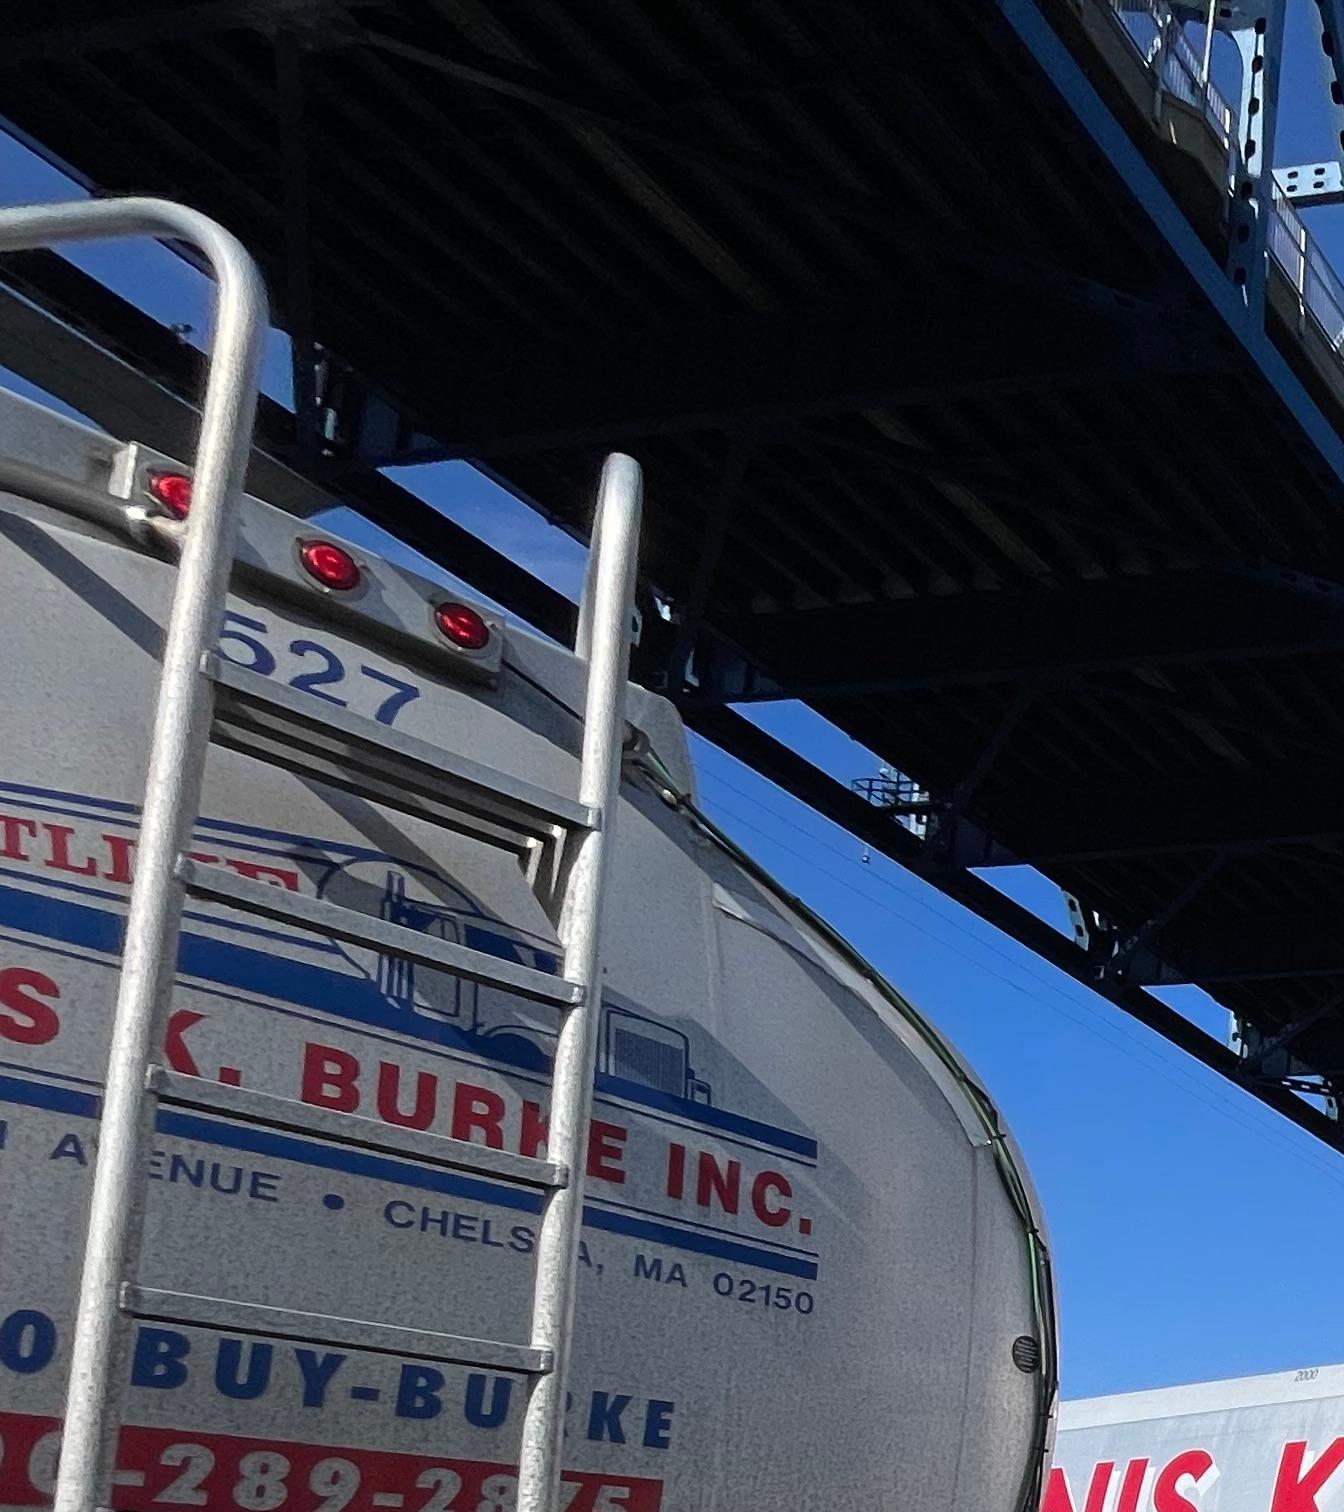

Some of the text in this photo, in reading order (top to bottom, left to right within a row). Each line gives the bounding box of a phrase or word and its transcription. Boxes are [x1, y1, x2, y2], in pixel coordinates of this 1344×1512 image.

[50, 1133, 282, 1202] AENUE
[384, 1200, 604, 1276] CHELSA,
[633, 1254, 688, 1288] MA
[713, 1272, 814, 1315] 02150
[667, 1143, 812, 1235] INC.
[131, 1326, 674, 1449] BUY-BUKE
